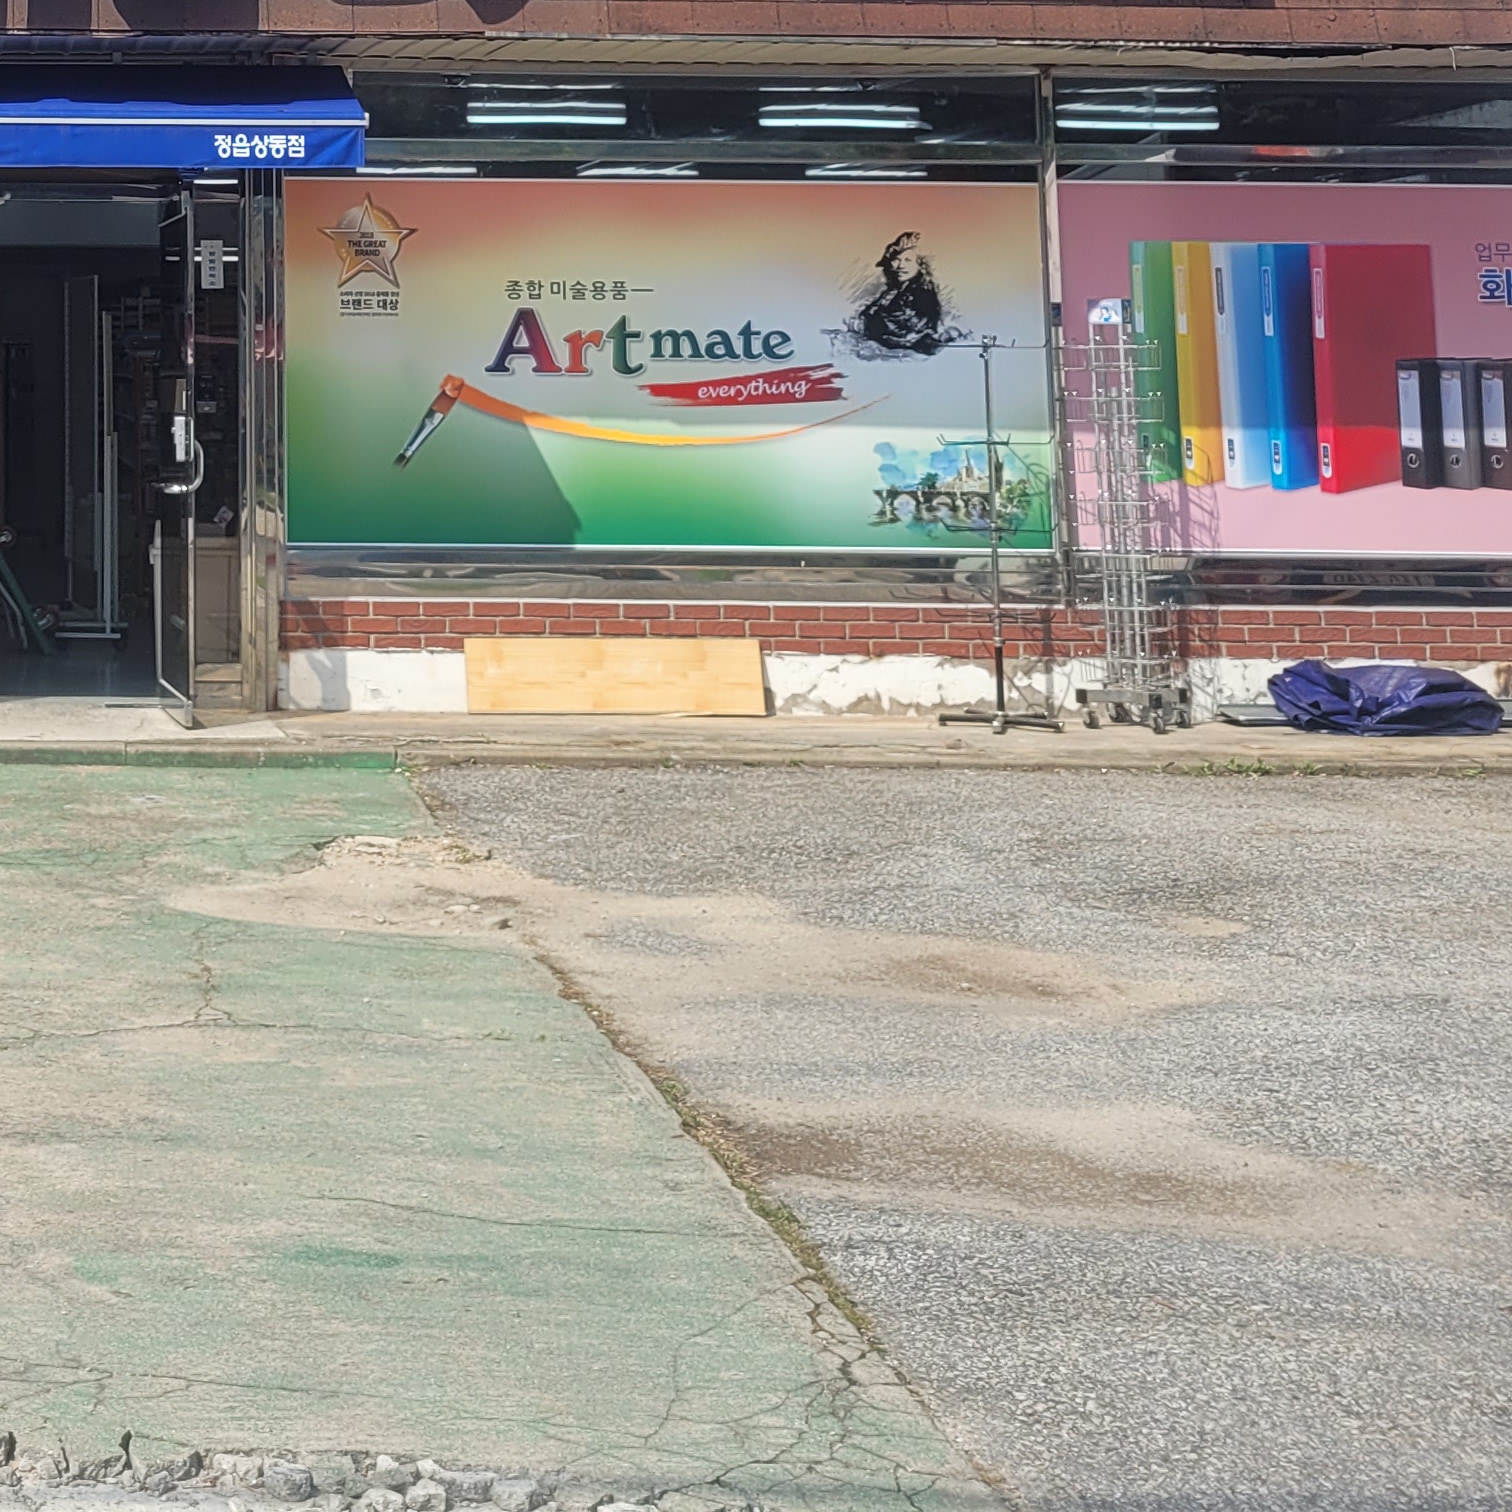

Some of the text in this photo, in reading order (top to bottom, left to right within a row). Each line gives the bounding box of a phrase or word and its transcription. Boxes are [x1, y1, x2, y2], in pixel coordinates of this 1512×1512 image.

[213, 133, 305, 159] 정읍상동점
[347, 240, 387, 249] THE GREAT
[354, 248, 381, 257] BRAND
[504, 279, 545, 301] 종합
[339, 298, 400, 311] 브랜드 대상
[697, 377, 811, 402] everything
